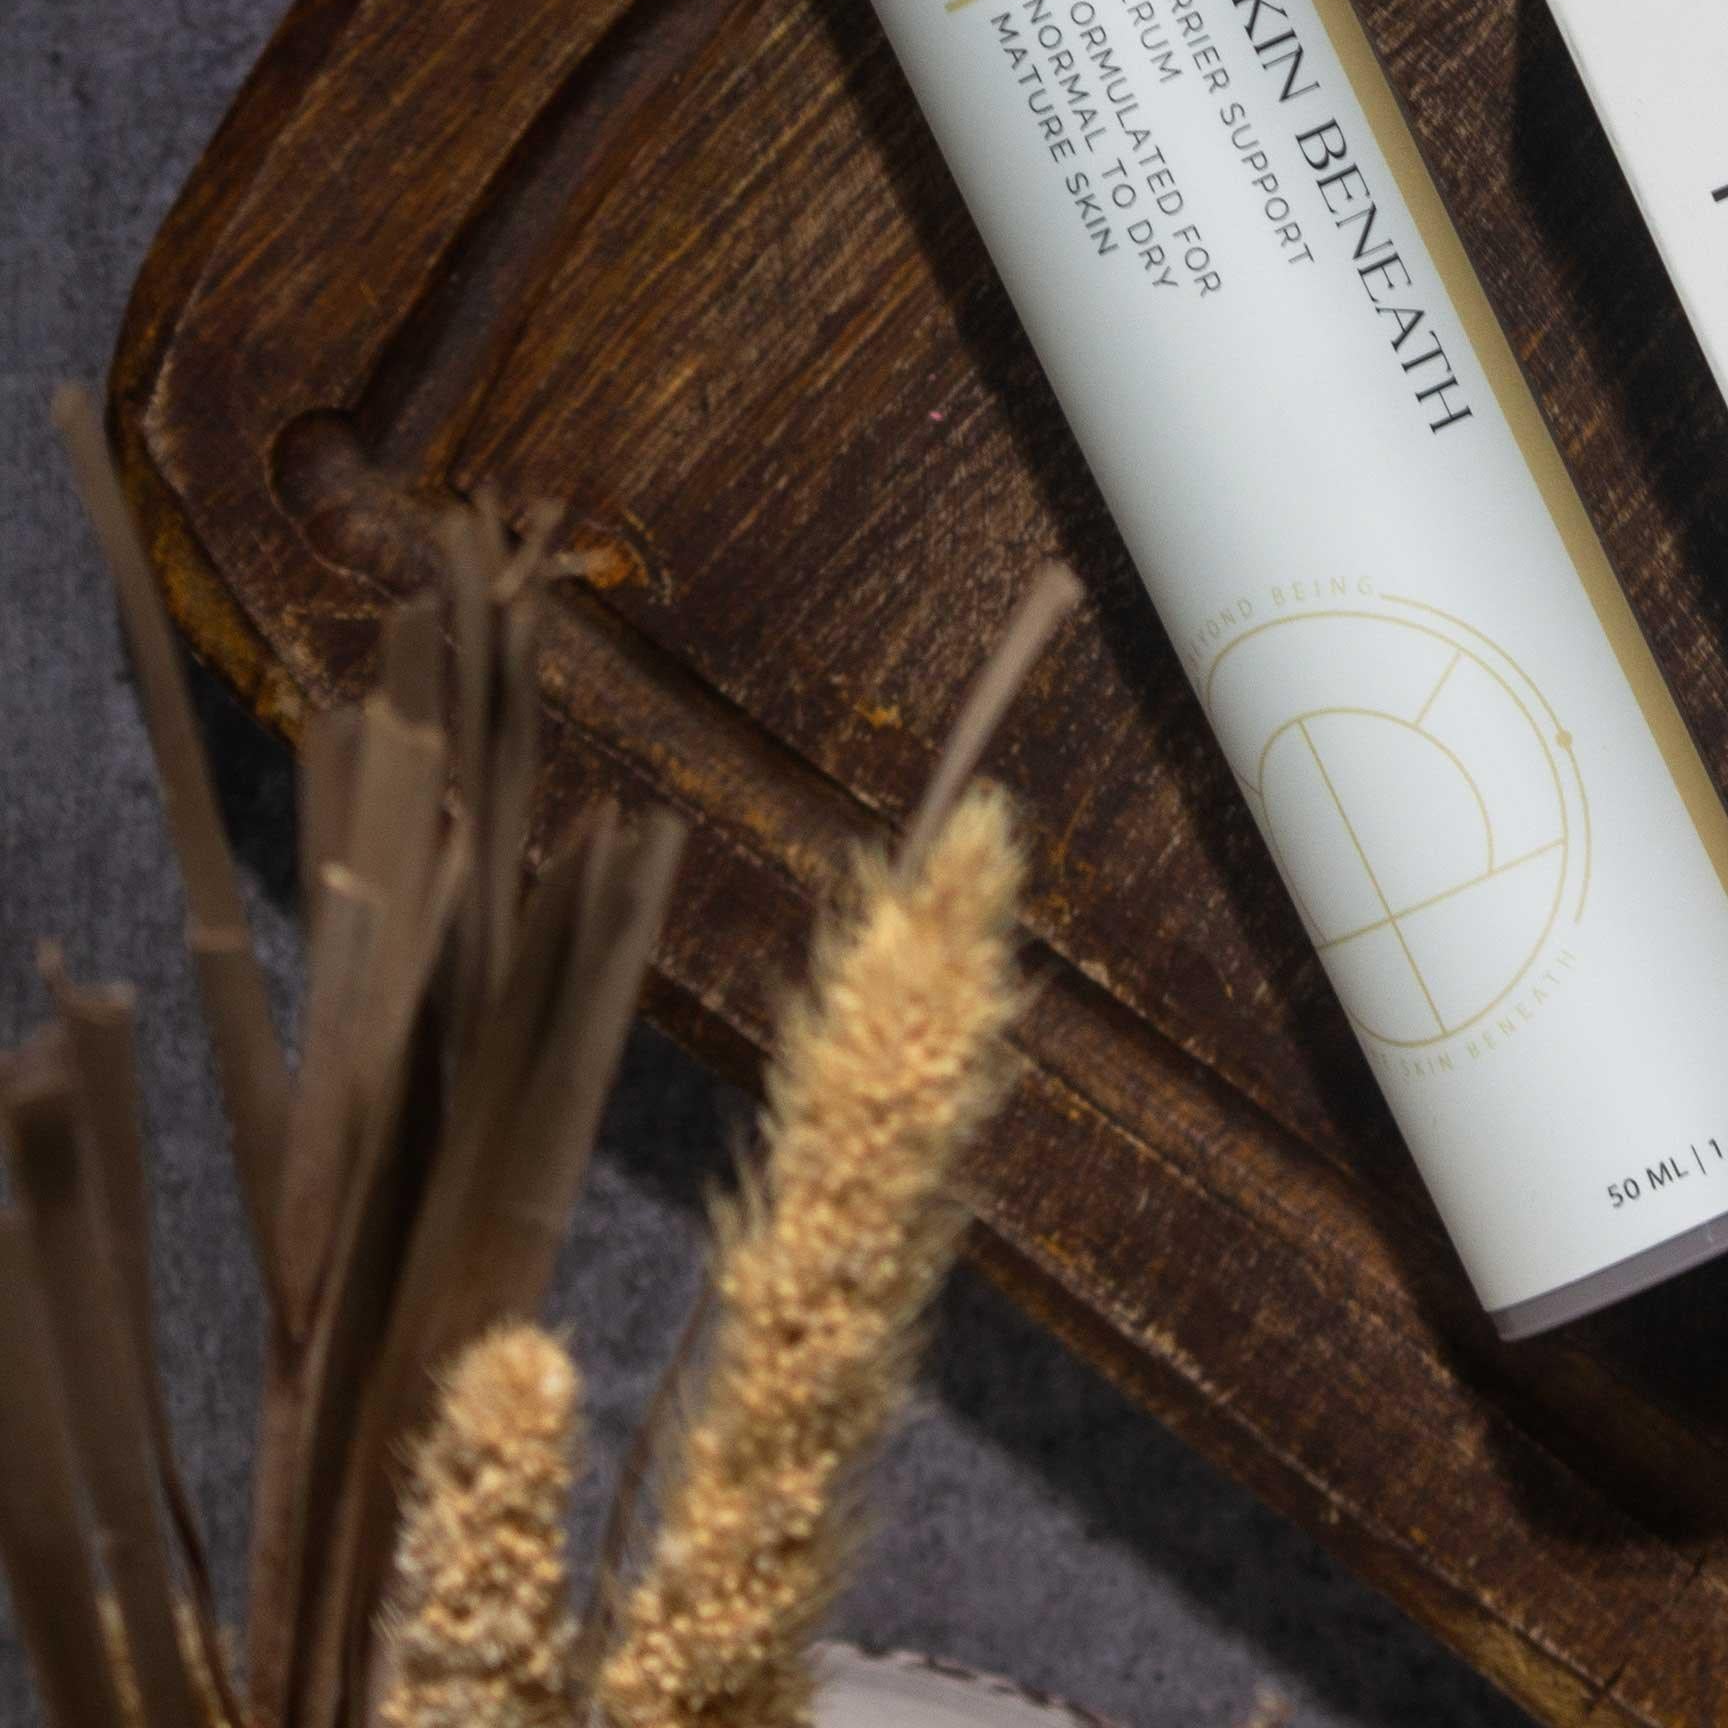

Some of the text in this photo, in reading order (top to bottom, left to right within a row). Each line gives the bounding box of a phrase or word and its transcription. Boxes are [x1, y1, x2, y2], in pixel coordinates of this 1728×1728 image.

[989, 12, 1119, 257] MATURE SKIN
[1219, 103, 1315, 268] SUPPORT
[1100, 159, 1137, 210] TO
[1125, 219, 1179, 291] DRY
[1173, 225, 1223, 298] FOR
[1295, 118, 1474, 434] BENEATH
[1607, 1177, 1641, 1208] 50
[1646, 1157, 1689, 1191] ML
